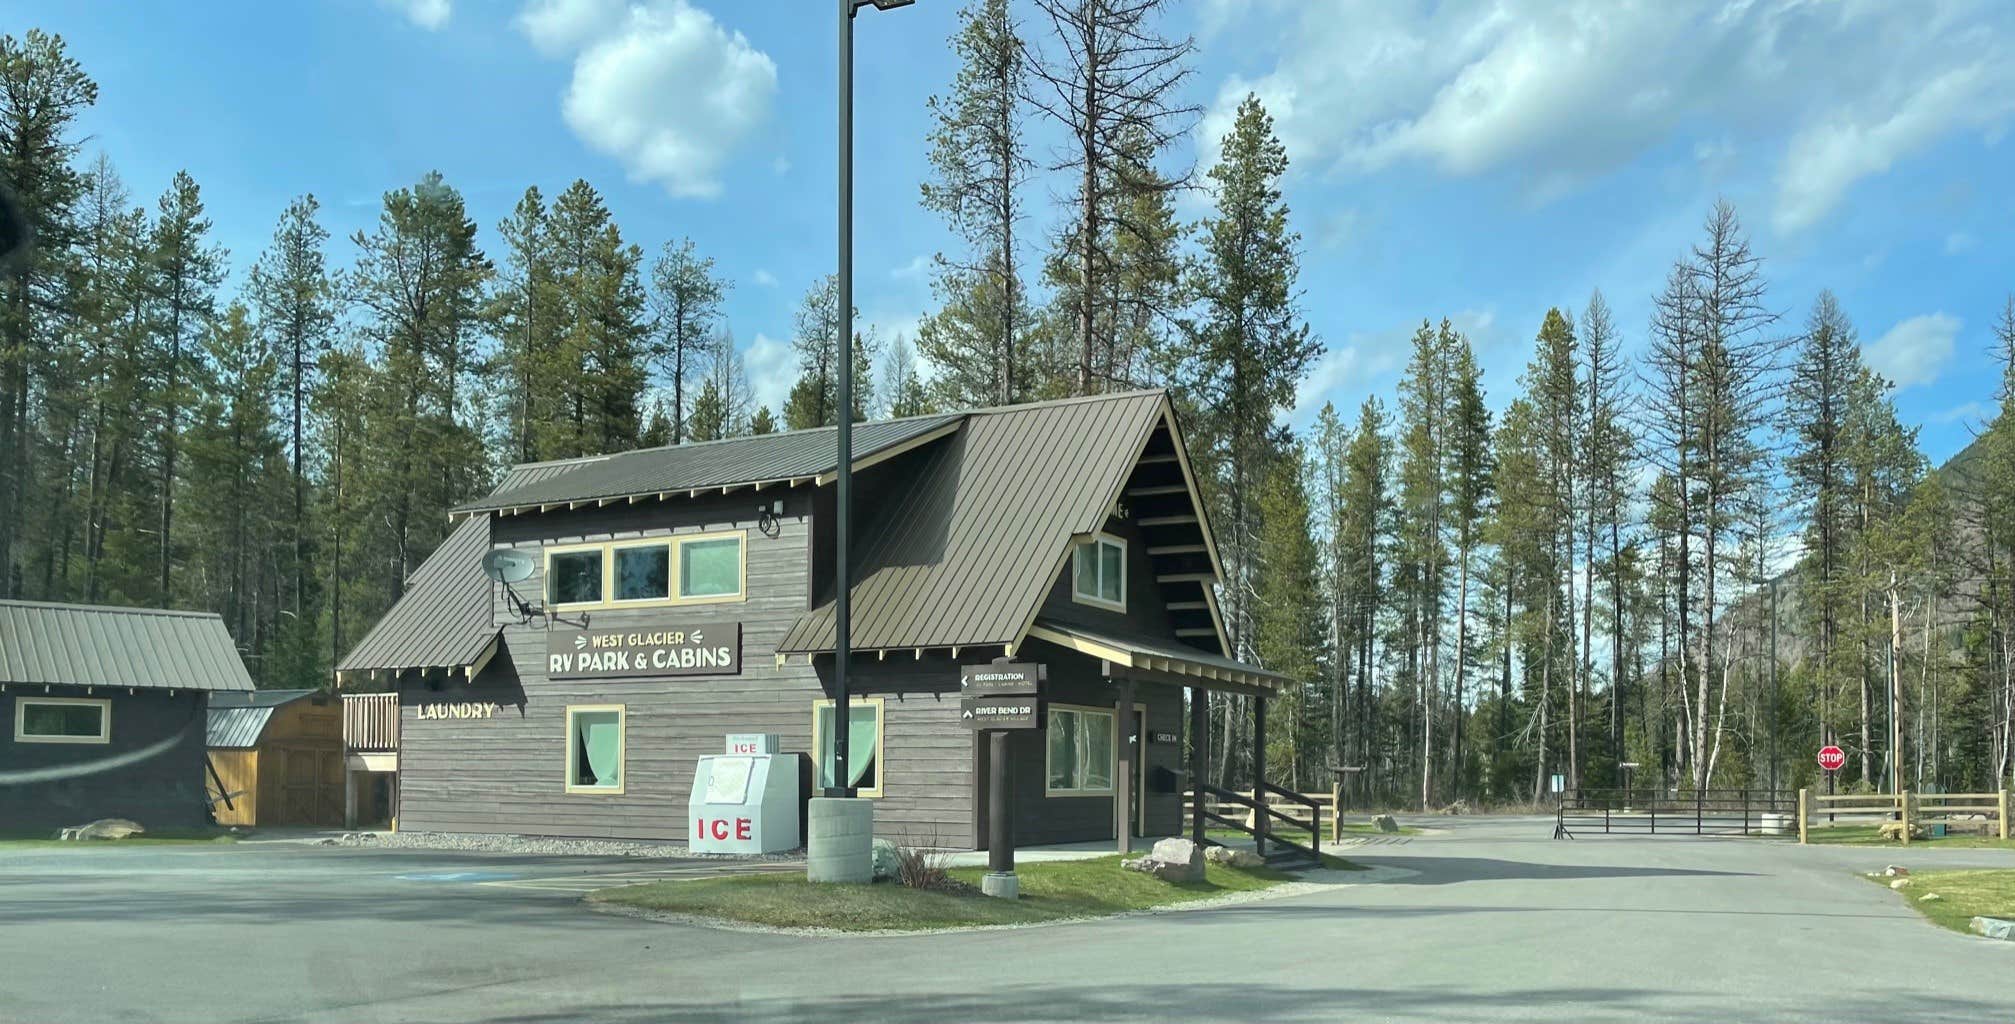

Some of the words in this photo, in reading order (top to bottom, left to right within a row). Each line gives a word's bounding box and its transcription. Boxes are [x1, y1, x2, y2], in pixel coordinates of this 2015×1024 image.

[592, 634, 624, 648] WEST
[628, 631, 685, 647] GLACIER
[550, 653, 574, 673] RV
[578, 650, 630, 672] PARK
[634, 652, 648, 670] &
[652, 646, 731, 669] CABINS
[974, 672, 1024, 681] REGISTRATION
[417, 701, 495, 720] LAUNDRY
[975, 706, 997, 715] RIVER
[998, 706, 1019, 715] BEND
[1019, 706, 1031, 714] DR
[734, 743, 757, 753] ICE
[1820, 753, 1843, 763] STOP
[698, 817, 752, 841] ICE
